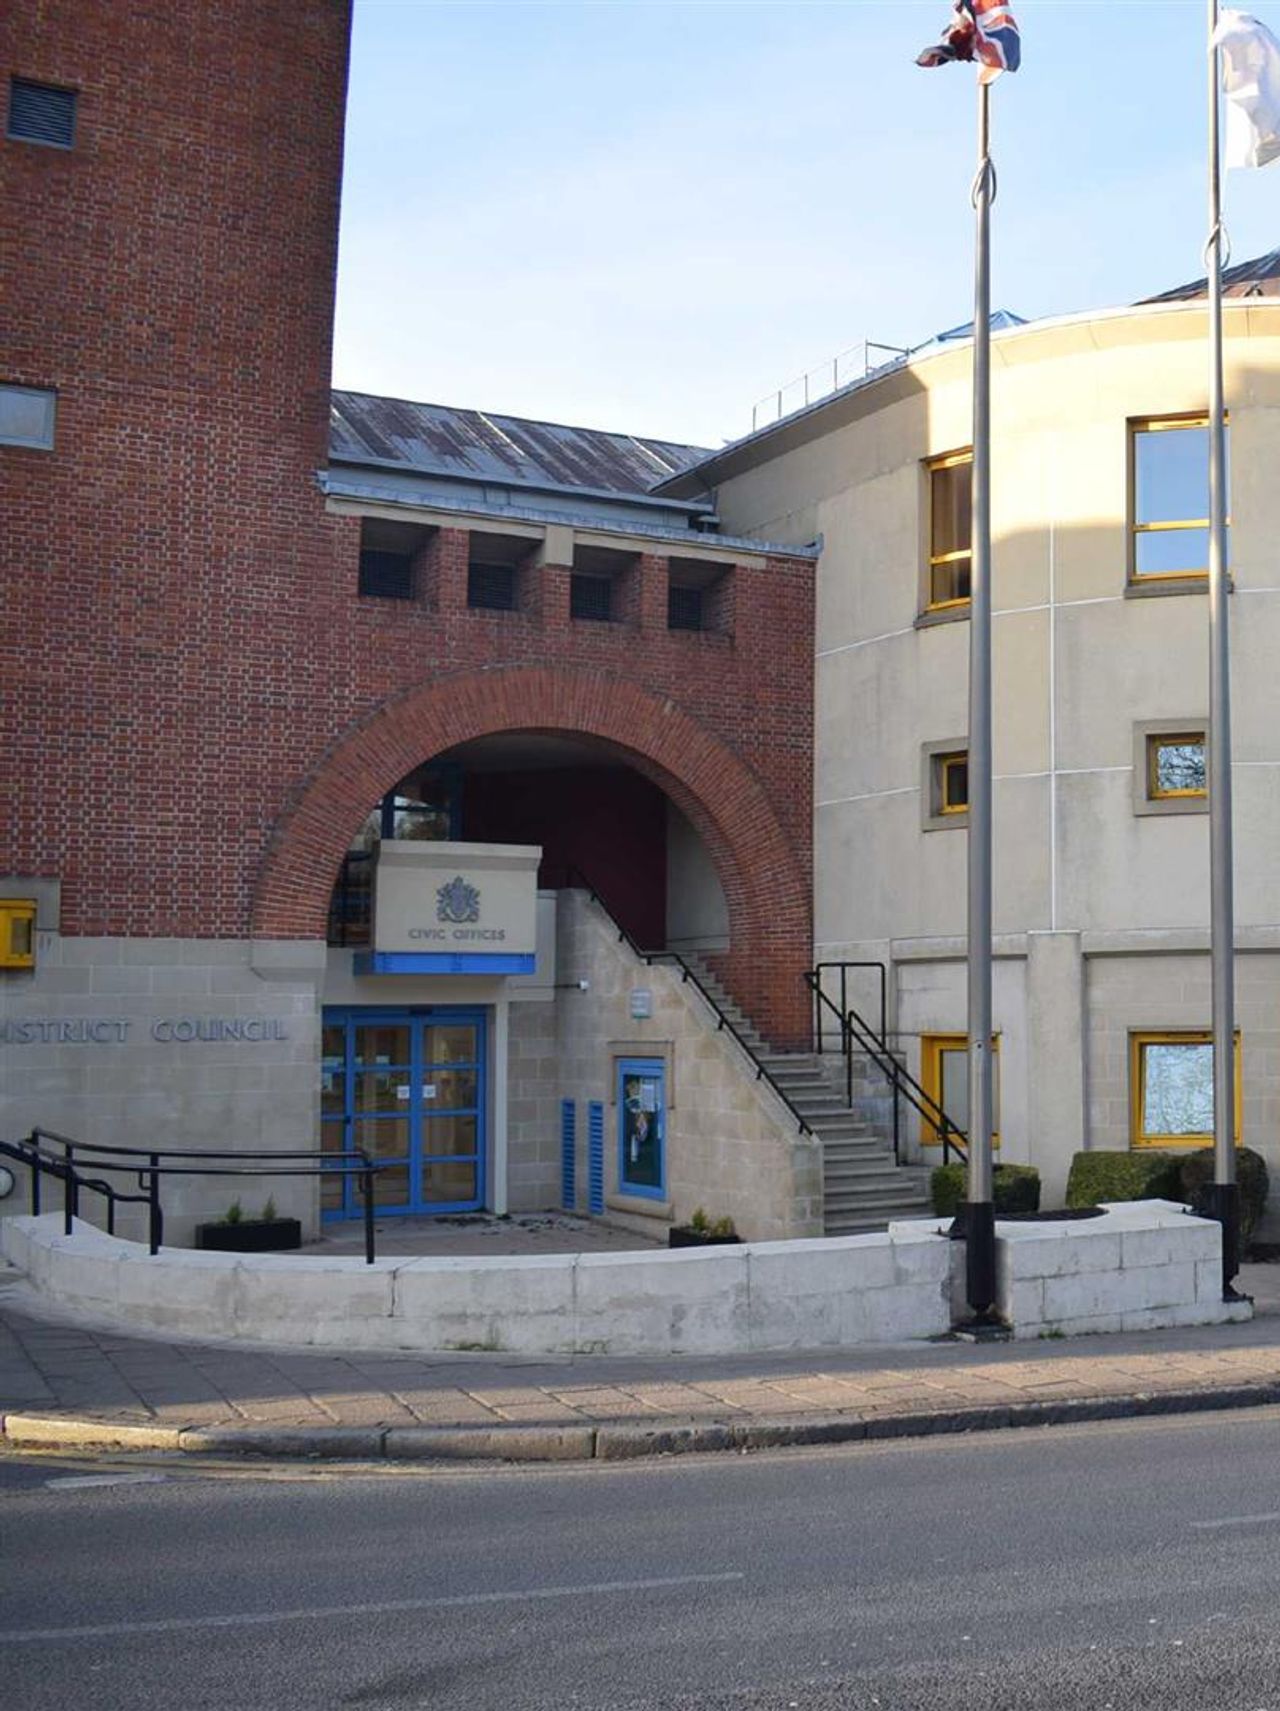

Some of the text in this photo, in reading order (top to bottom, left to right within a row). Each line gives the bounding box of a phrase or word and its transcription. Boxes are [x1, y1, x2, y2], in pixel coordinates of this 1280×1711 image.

[407, 928, 505, 940] CIVIC OFFICES
[0, 1018, 288, 1043] ISTRICT COUNCIL
